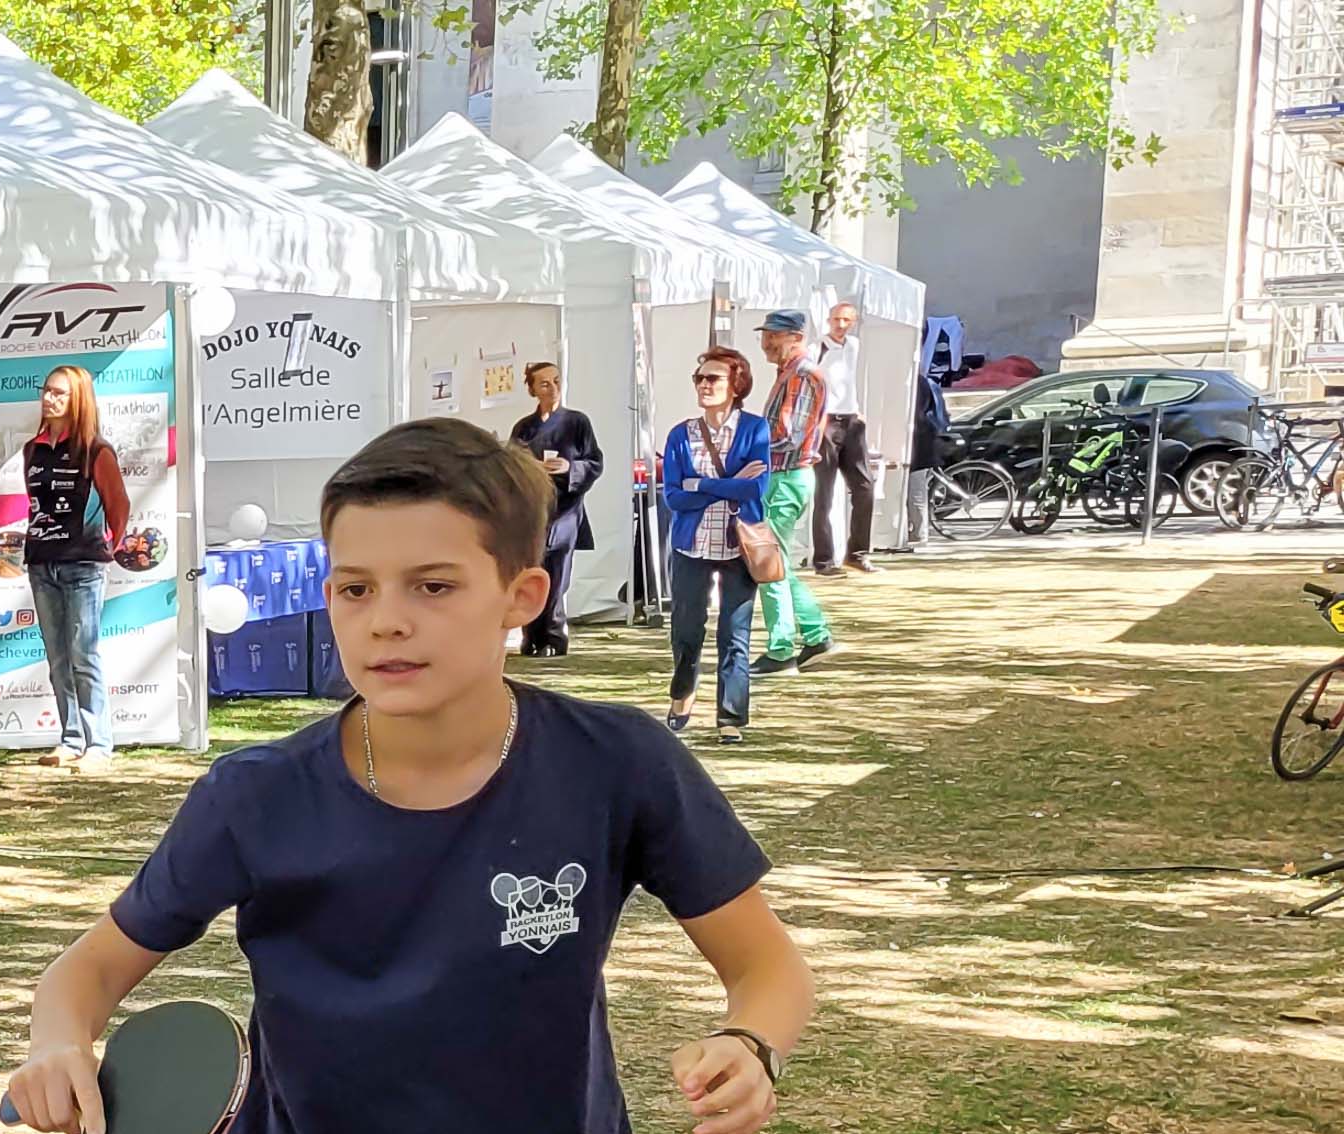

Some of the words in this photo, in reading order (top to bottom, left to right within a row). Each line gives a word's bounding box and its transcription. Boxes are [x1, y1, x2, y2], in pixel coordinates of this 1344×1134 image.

[0, 342, 37, 354] ROCHE
[202, 326, 259, 360] DOJO
[266, 321, 361, 359] YONAIS
[1, 375, 40, 390] ROCHE
[231, 367, 291, 390] Salle
[300, 365, 331, 387] de
[110, 683, 160, 696] RSPORT
[510, 911, 571, 930] RACKETLON
[508, 920, 572, 942] YONNAIS
